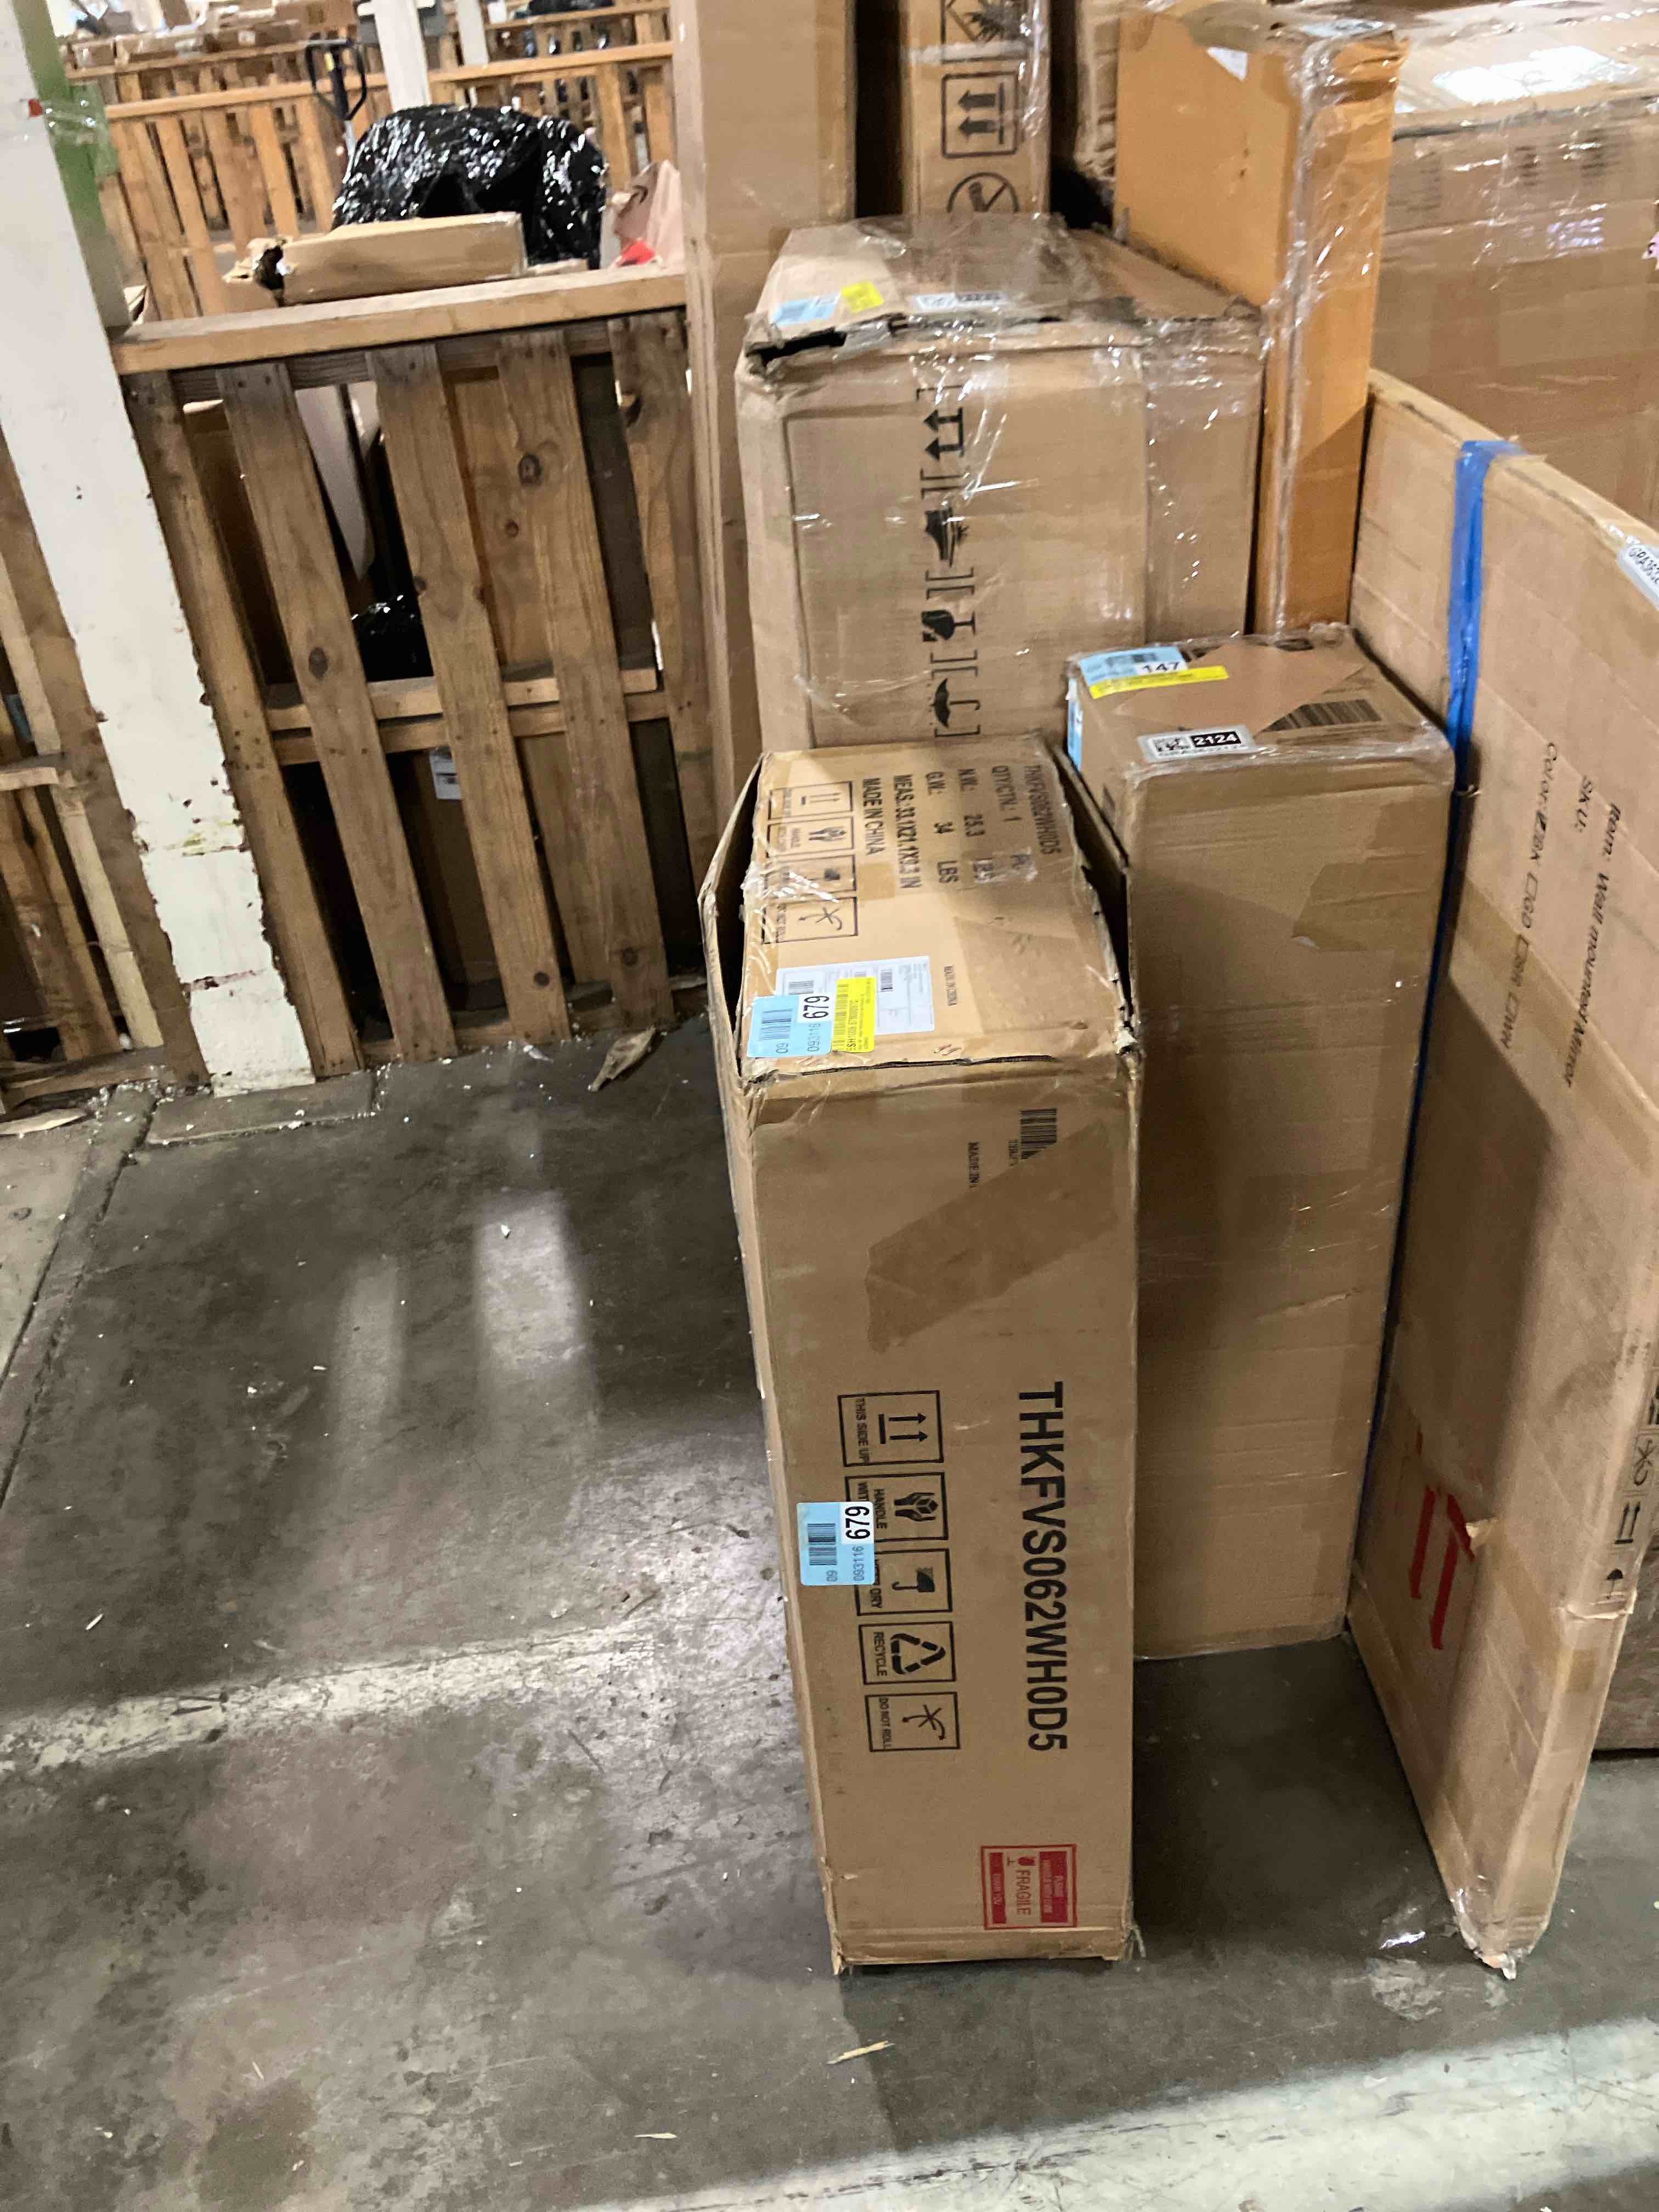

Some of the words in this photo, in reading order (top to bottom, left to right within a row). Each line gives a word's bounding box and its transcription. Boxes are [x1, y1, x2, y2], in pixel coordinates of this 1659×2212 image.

[1143, 662, 1179, 673] 147
[1194, 733, 1238, 746] 2124
[1538, 742, 1558, 810] Color:
[862, 777, 882, 806] MADE
[864, 808, 883, 820] IN
[1575, 775, 1593, 833] SKU:
[865, 820, 886, 856] CHINA
[934, 821, 956, 834] 34
[1601, 803, 1621, 862] Item:
[899, 876, 922, 889] IN
[937, 860, 960, 884] LBS
[1593, 872, 1610, 925] Wall
[1579, 926, 1599, 1024] mounted
[803, 995, 830, 1019] 679
[1564, 1020, 1585, 1088] Mirror
[855, 1398, 866, 1420] THIS
[857, 1423, 868, 1446] SIDE
[859, 1449, 870, 1465] UP
[857, 1482, 868, 1502] WIT
[872, 1488, 887, 1530] HANDLE
[844, 1505, 871, 1540] 679
[851, 1545, 865, 1582] 093116
[1019, 1381, 1068, 1751] THKFVS062WH0D5
[826, 1570, 838, 1583] 09
[869, 1588, 882, 1609] DRY
[873, 1631, 888, 1677] RECYCLE
[879, 1696, 889, 1711] DO
[880, 1712, 890, 1727] NOT
[882, 1729, 892, 1749] ROLL
[1015, 1869, 1032, 1916] FRAGILE
